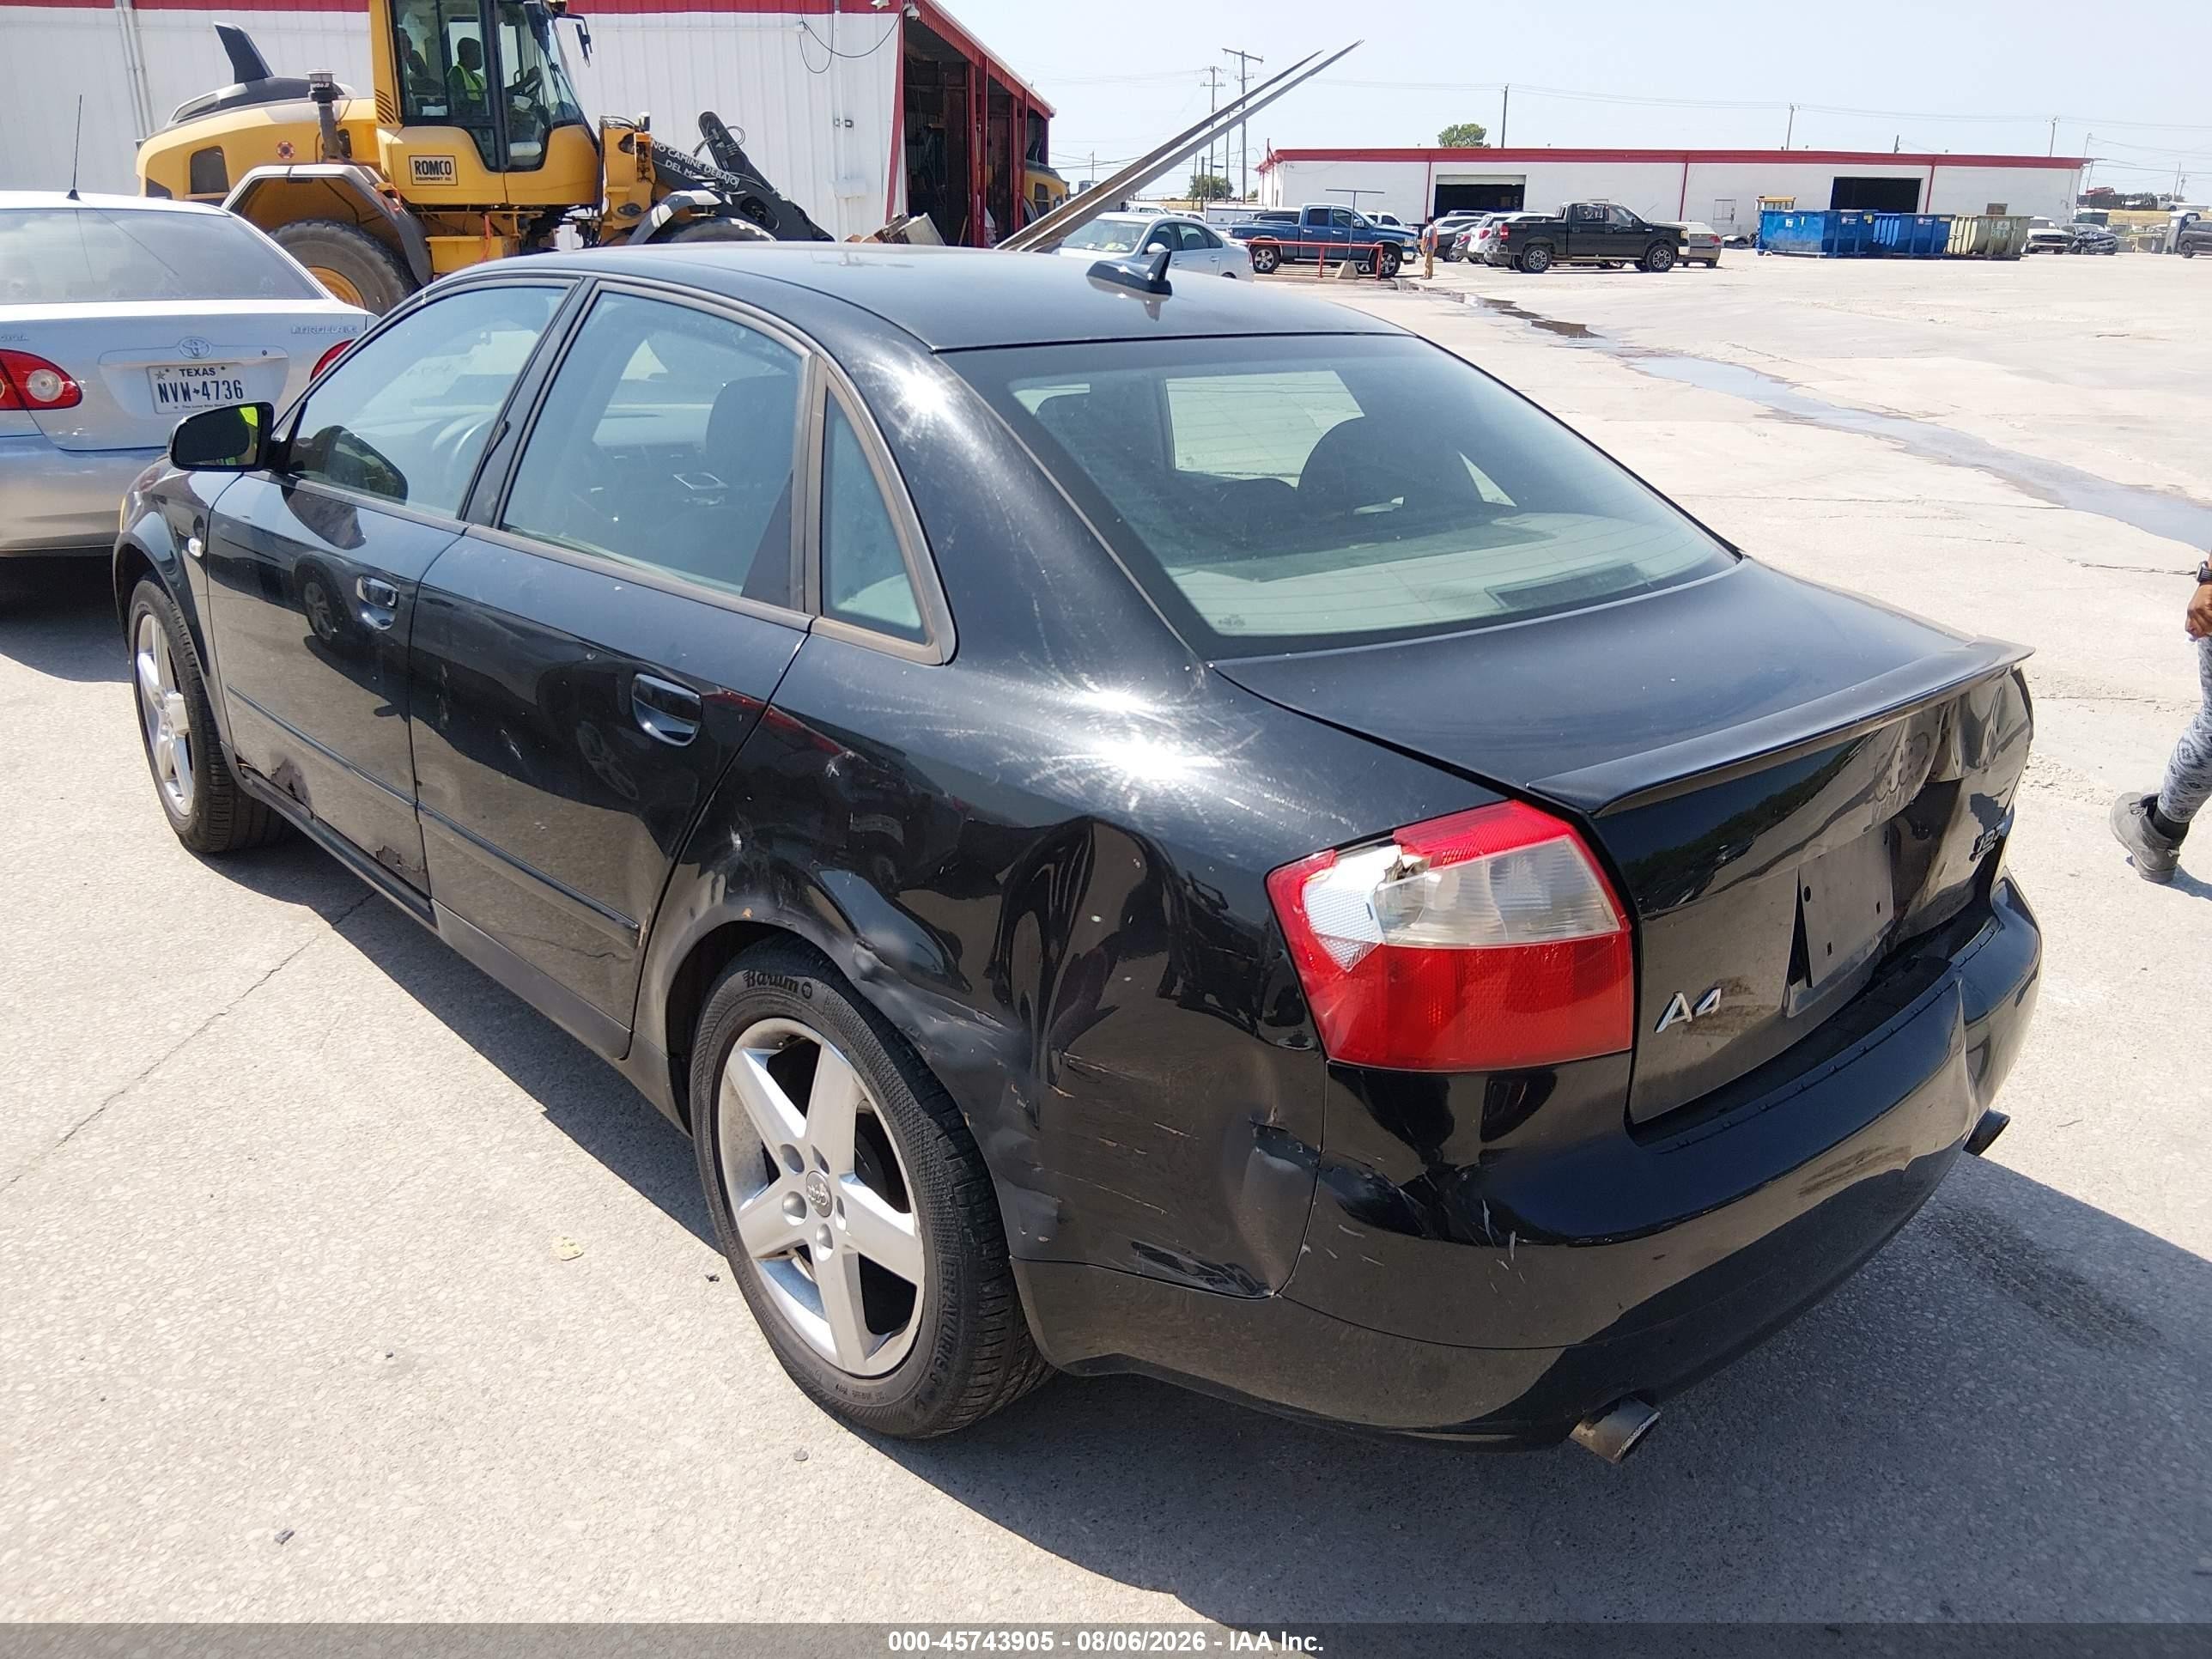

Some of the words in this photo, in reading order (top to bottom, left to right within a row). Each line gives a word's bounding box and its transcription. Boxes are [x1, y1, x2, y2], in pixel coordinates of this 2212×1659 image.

[414, 160, 453, 176] ROMCO
[653, 141, 666, 152] NO
[668, 147, 702, 170] CAMINE
[704, 164, 739, 188] DEBAJO
[665, 159, 682, 175] DEL
[179, 367, 216, 378] TEXAS
[157, 381, 192, 404] NVW
[202, 379, 244, 401] 4736
[742, 970, 799, 994] Barum
[1654, 988, 1722, 1034] A4
